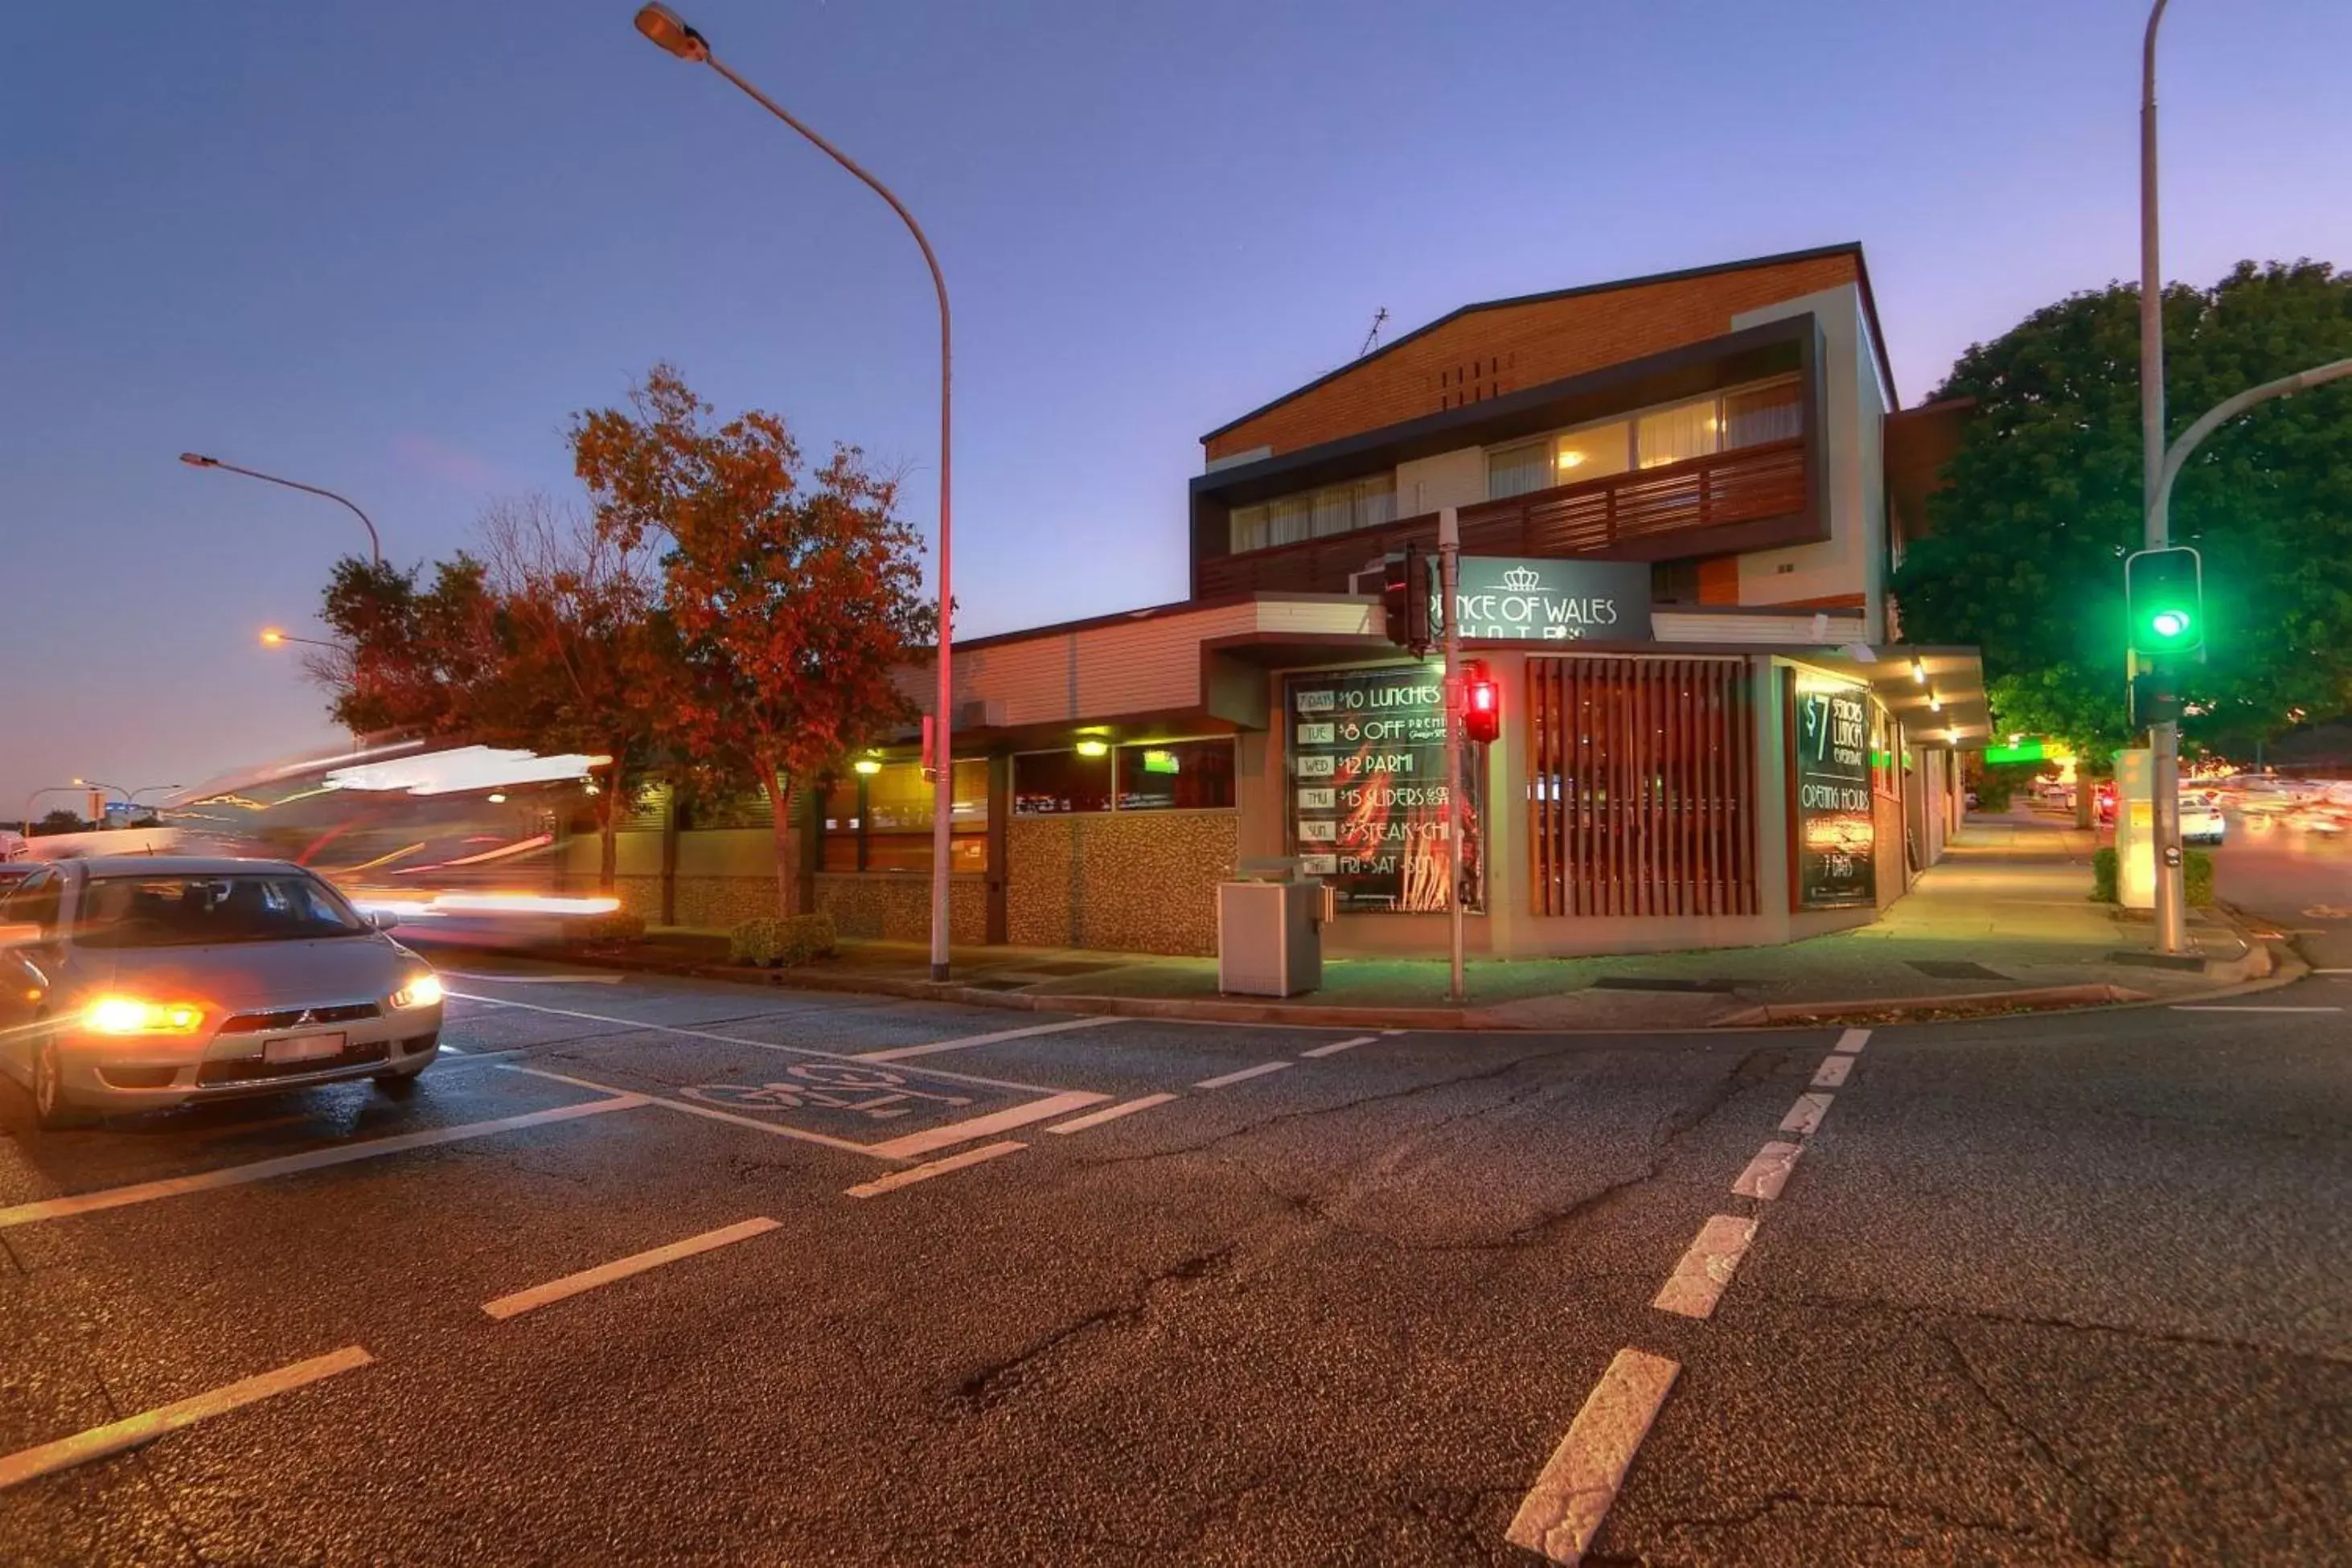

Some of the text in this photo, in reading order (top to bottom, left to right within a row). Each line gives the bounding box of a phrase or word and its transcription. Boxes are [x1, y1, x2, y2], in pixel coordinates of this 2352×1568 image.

[1430, 593, 1617, 625] NCE OF WALES
[1458, 625, 1586, 639] HOTE
[1339, 685, 1441, 708] $10 LUNCHES
[1307, 726, 1327, 740] TUE
[1339, 723, 1361, 741] $8
[1364, 720, 1405, 740] OFF
[1806, 692, 1830, 761] $7
[1833, 718, 1863, 749] LUNCH
[1304, 759, 1328, 772] WED
[1339, 753, 1413, 774] $12 PARMI
[1307, 792, 1327, 804] THU
[1340, 789, 1361, 807] $15
[1365, 787, 1424, 807] SLIDERS
[1802, 783, 1870, 811] OPENING HOURS
[1340, 822, 1357, 841] $7
[1361, 822, 1414, 841] STEAK
[1421, 821, 1449, 840] CHI
[1340, 856, 1361, 874] FRI
[1371, 856, 1397, 874] SAT
